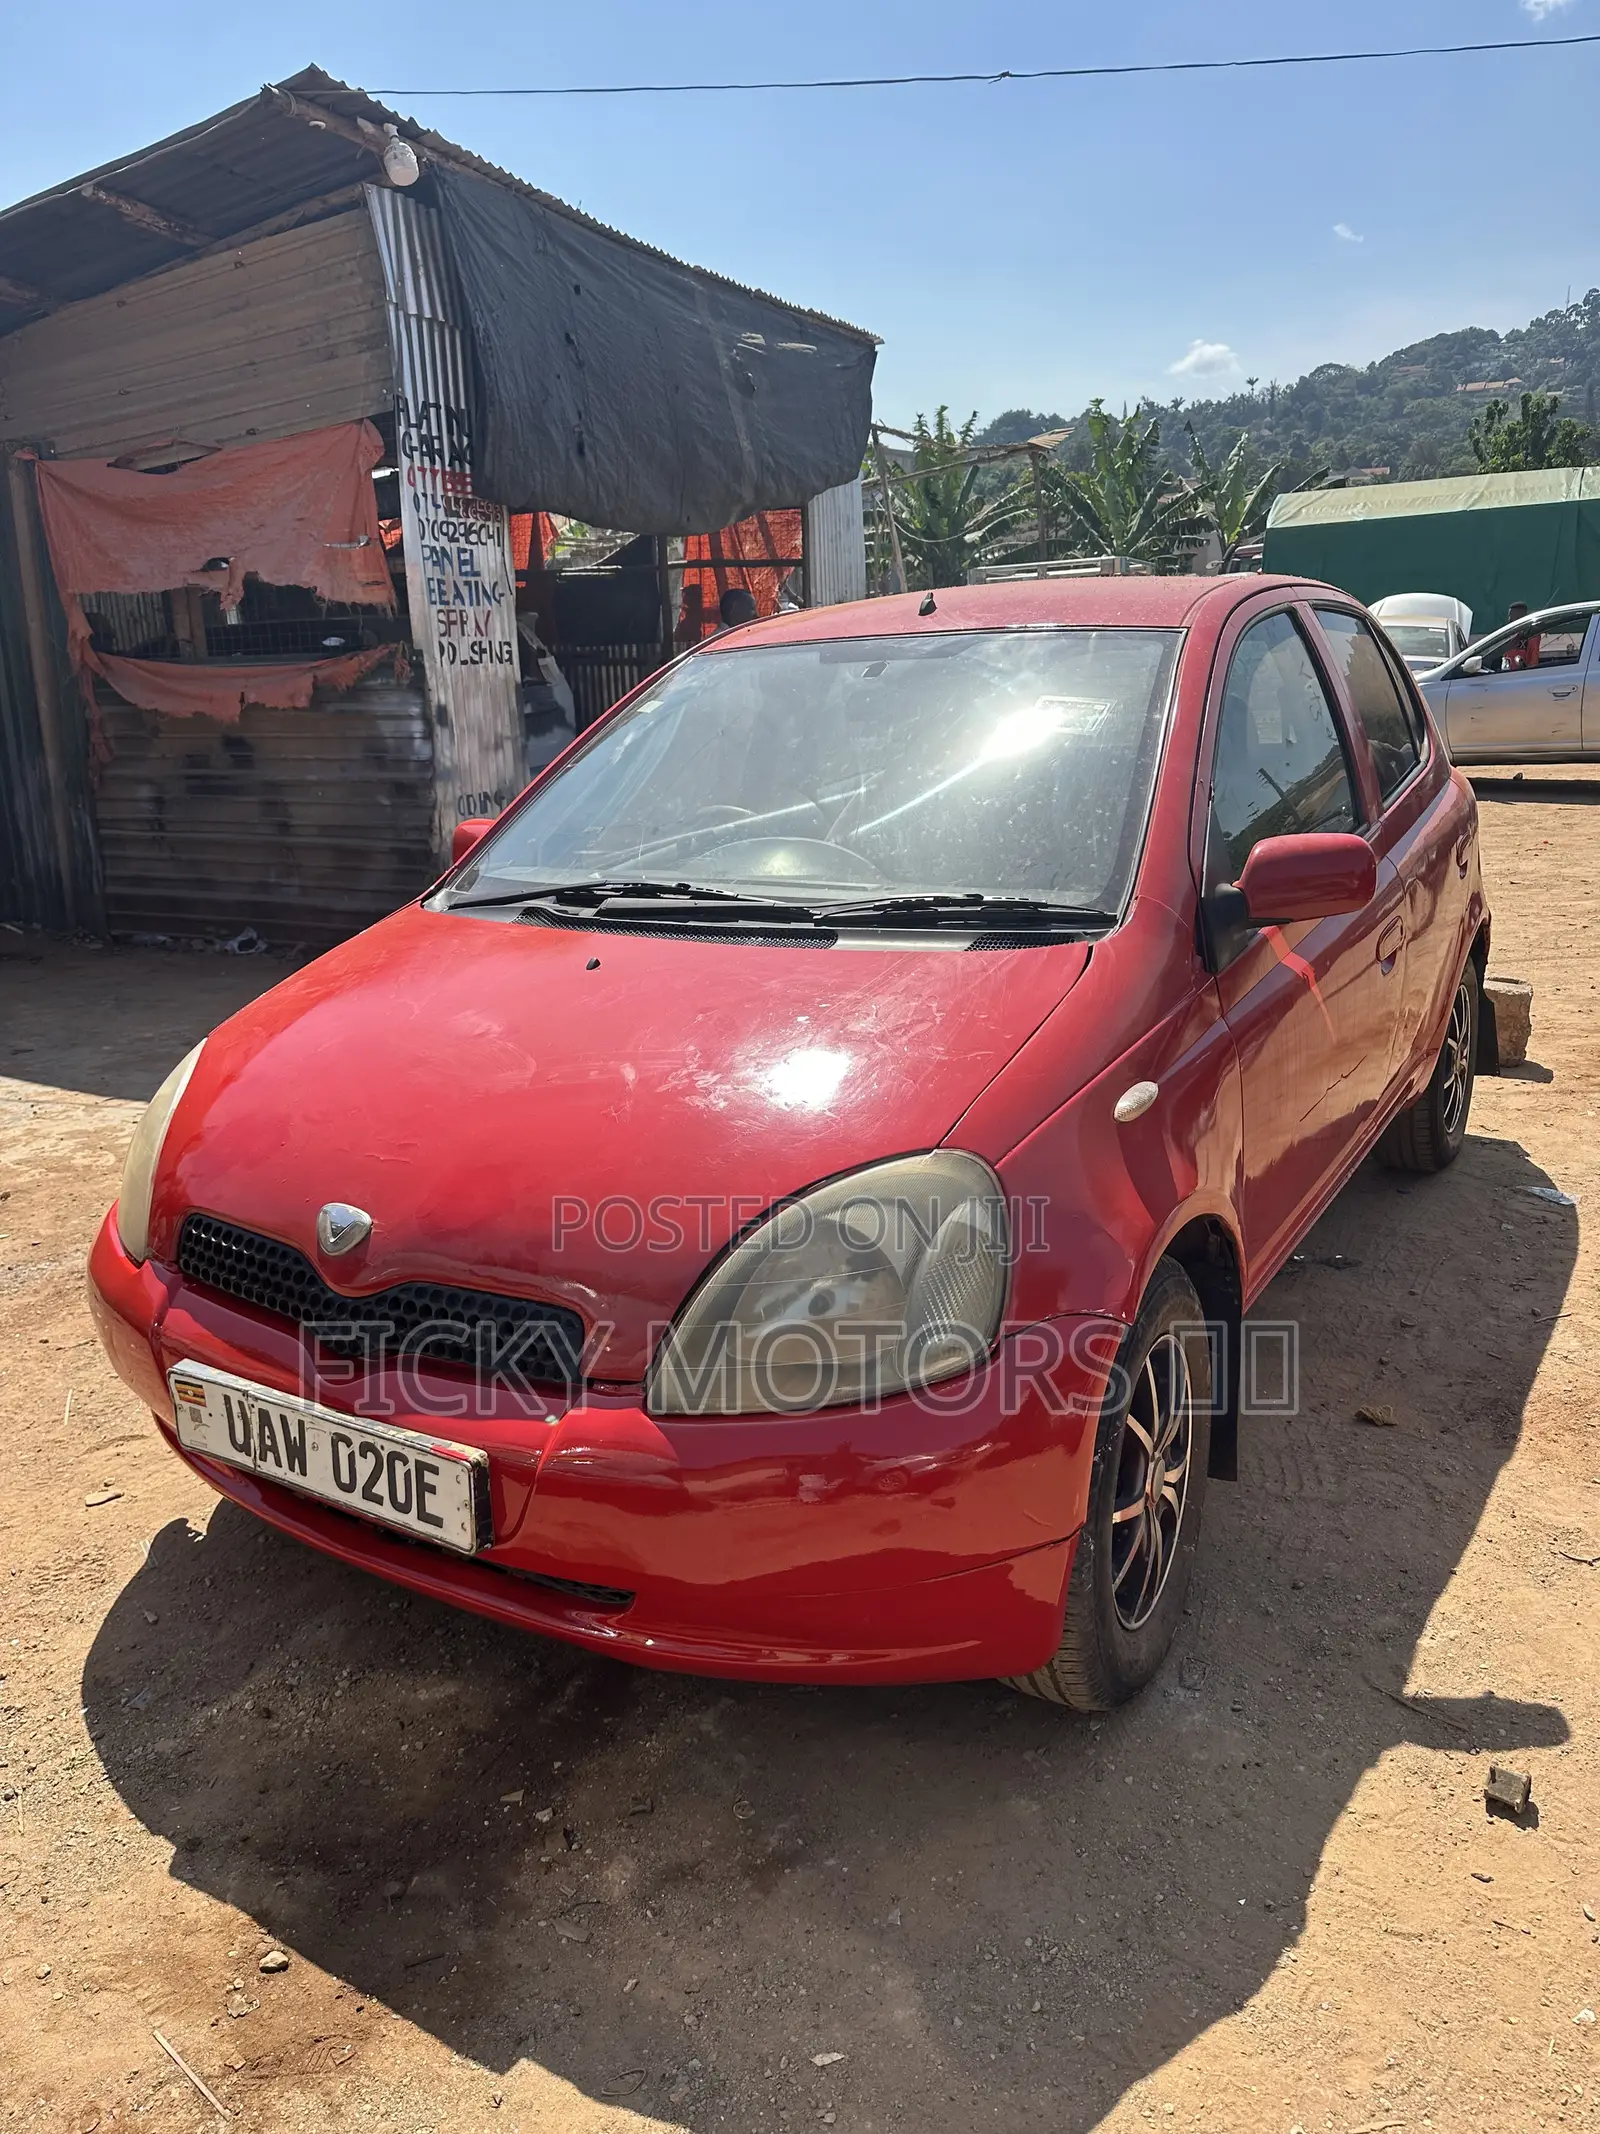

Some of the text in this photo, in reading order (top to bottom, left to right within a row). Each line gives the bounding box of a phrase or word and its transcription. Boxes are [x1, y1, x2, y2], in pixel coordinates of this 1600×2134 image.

[421, 544, 481, 577] PANEL
[437, 609, 491, 637] SPRAY
[223, 1394, 444, 1528] UAW 020E
